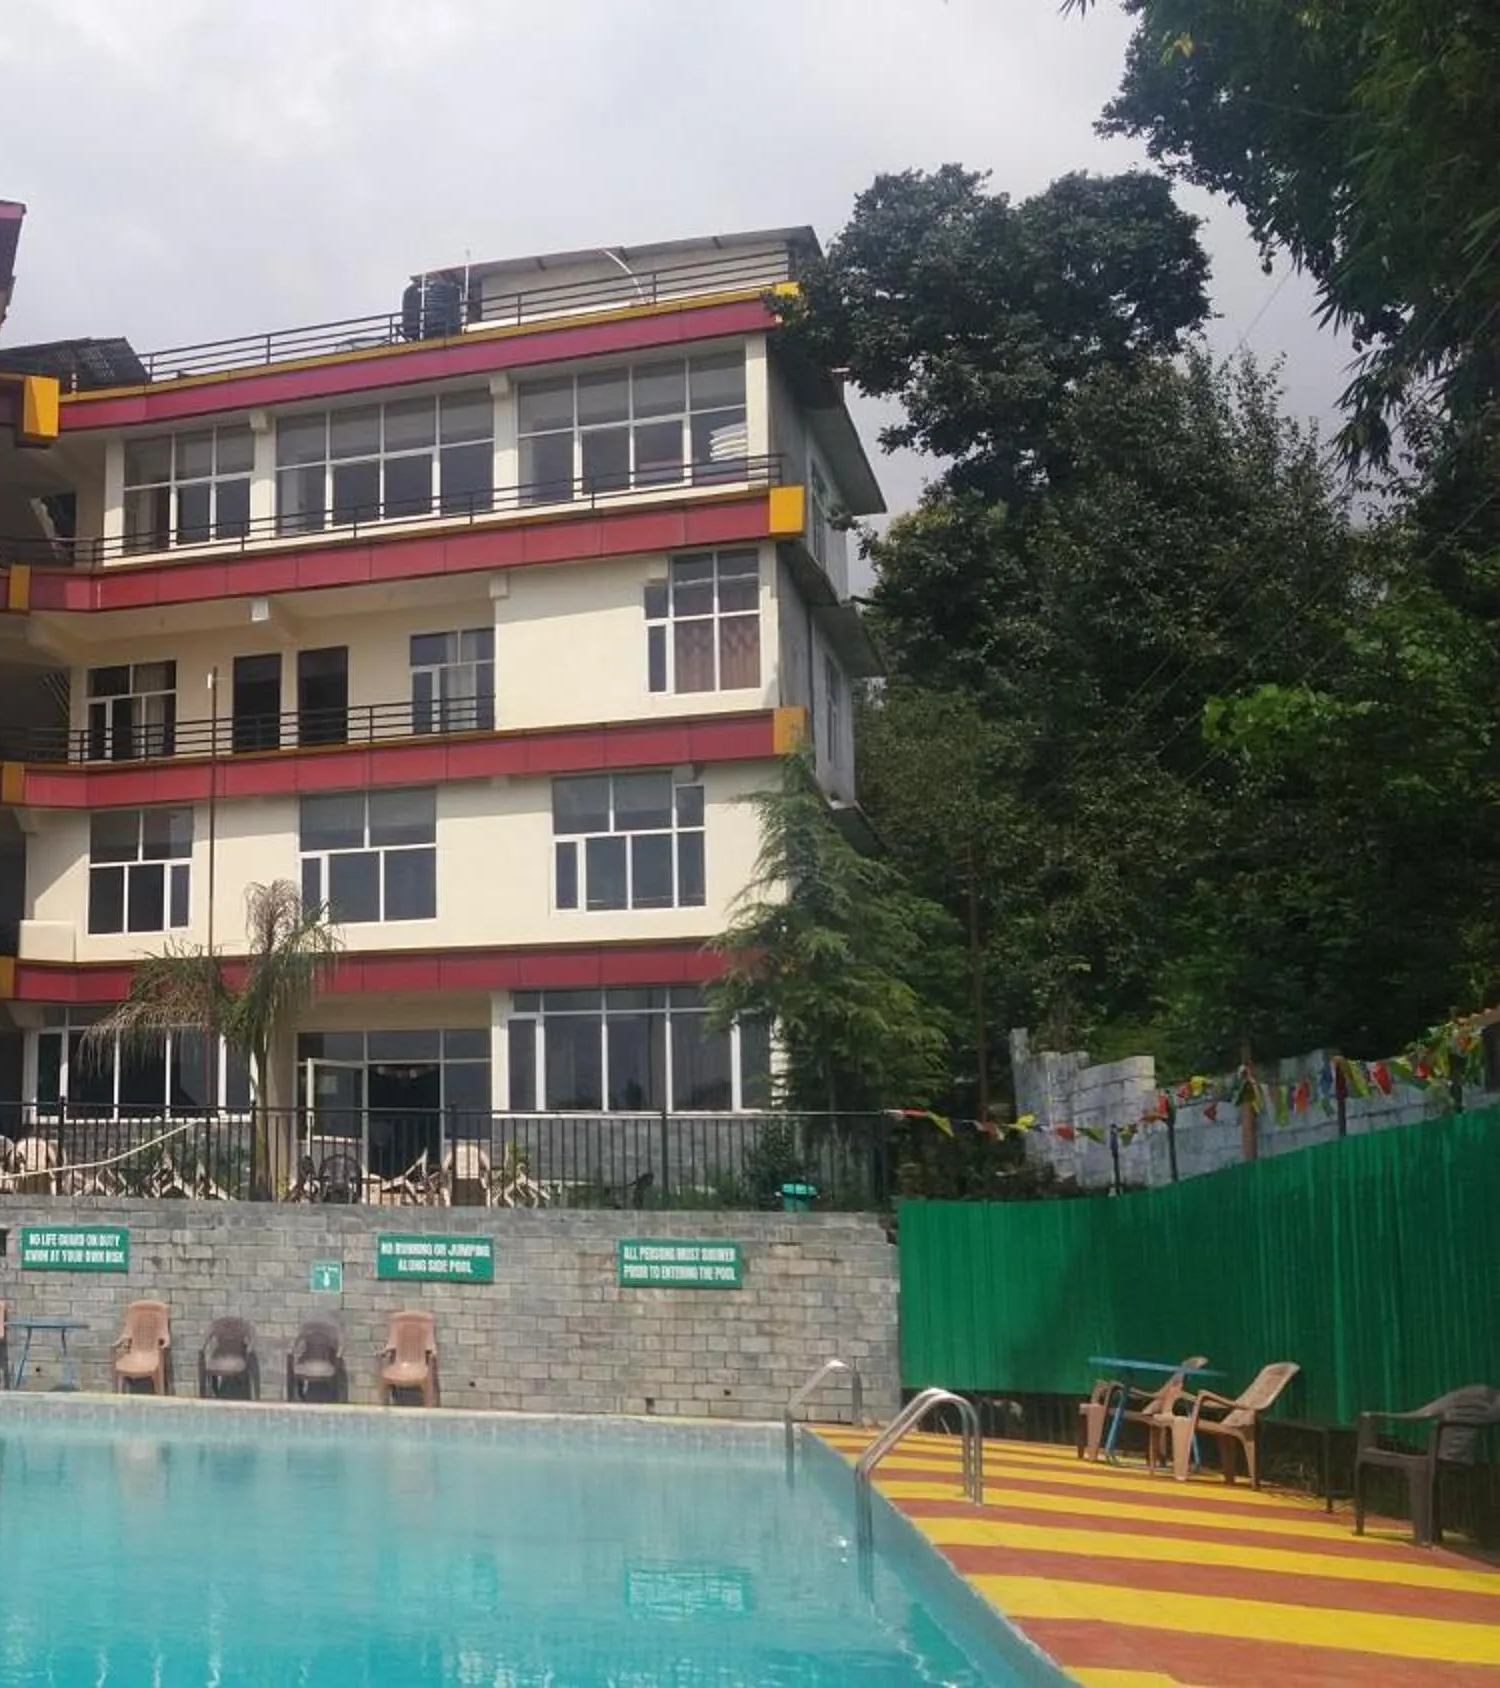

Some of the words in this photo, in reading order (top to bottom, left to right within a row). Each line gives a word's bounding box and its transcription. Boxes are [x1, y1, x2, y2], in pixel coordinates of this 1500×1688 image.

[29, 1233, 40, 1246] NO
[41, 1233, 57, 1246] LIFE
[58, 1233, 85, 1247] GUARD
[99, 1234, 121, 1247] DUTY
[50, 1249, 60, 1262] AT
[61, 1249, 83, 1263] YOUR
[85, 1250, 104, 1263] OWN
[105, 1250, 125, 1263] RISK
[381, 1242, 393, 1255] NO
[447, 1243, 490, 1257] JUMPING
[623, 1246, 638, 1260] ALL
[397, 1258, 426, 1272] ALONG
[427, 1259, 448, 1272] SIDE
[449, 1260, 472, 1273] POOL
[623, 1264, 648, 1278] PRIOR
[649, 1265, 660, 1279] TO
[661, 1265, 698, 1280] ENTERING
[699, 1265, 714, 1280] THE
[715, 1266, 737, 1280] POOL
